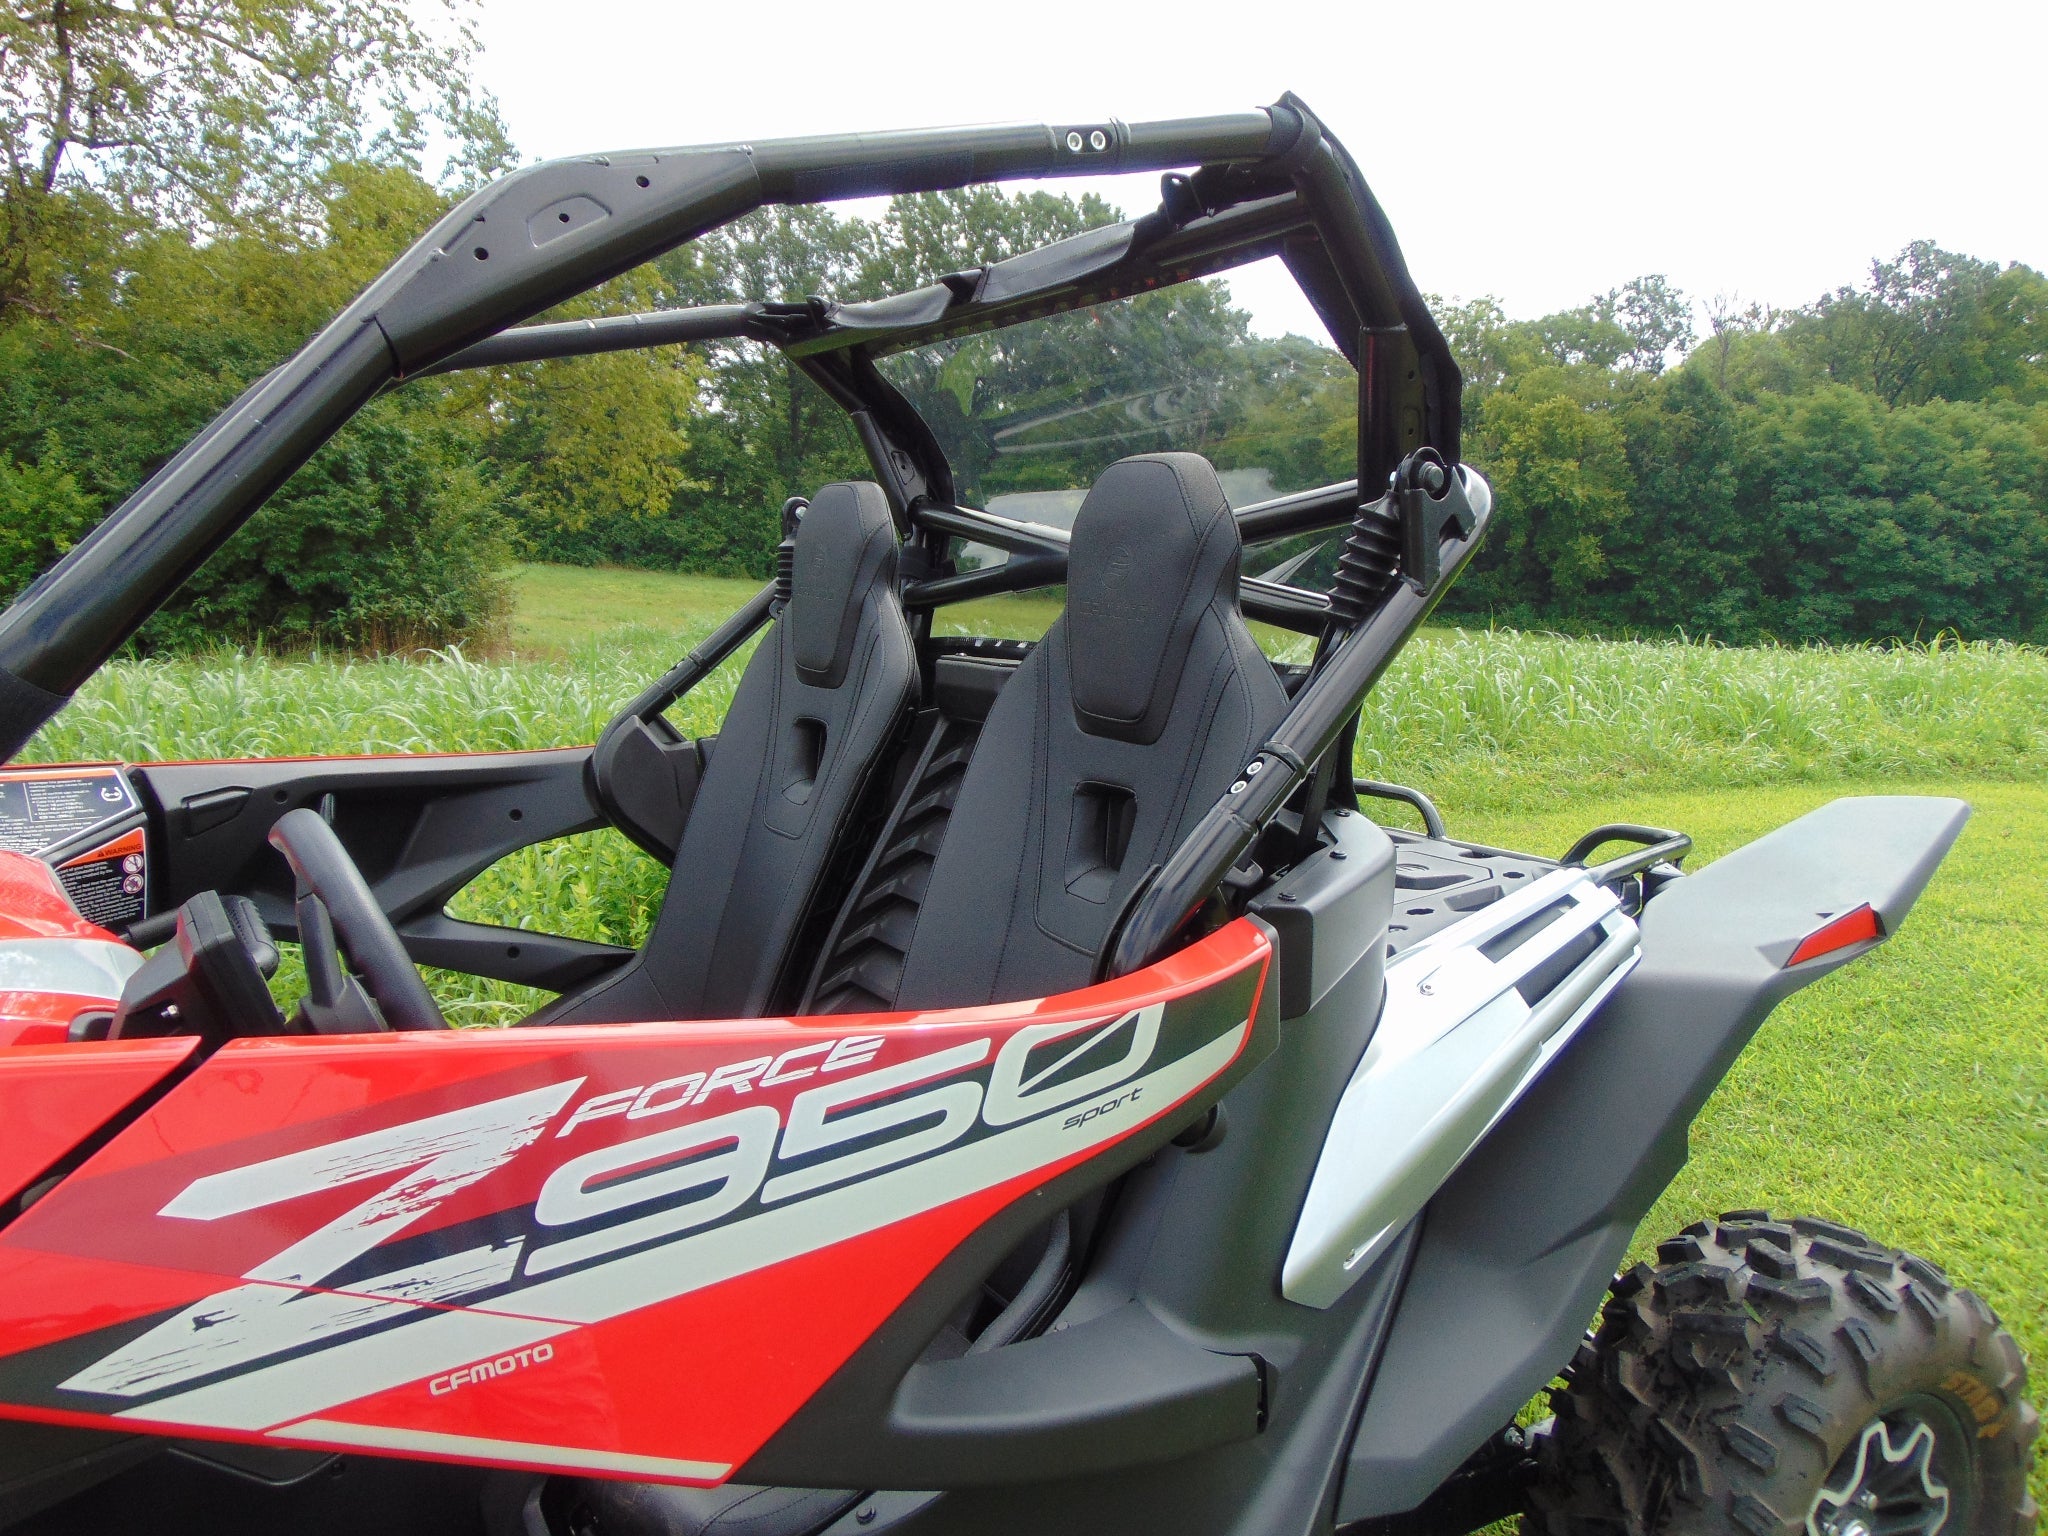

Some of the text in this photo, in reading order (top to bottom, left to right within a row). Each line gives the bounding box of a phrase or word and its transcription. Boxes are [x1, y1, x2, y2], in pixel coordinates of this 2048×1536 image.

[106, 843, 142, 857] WARNING
[556, 1034, 887, 1138] FORCE
[1062, 1087, 1143, 1131] sport
[524, 1002, 1165, 1277] 950
[430, 1343, 554, 1396] CFMOTO
